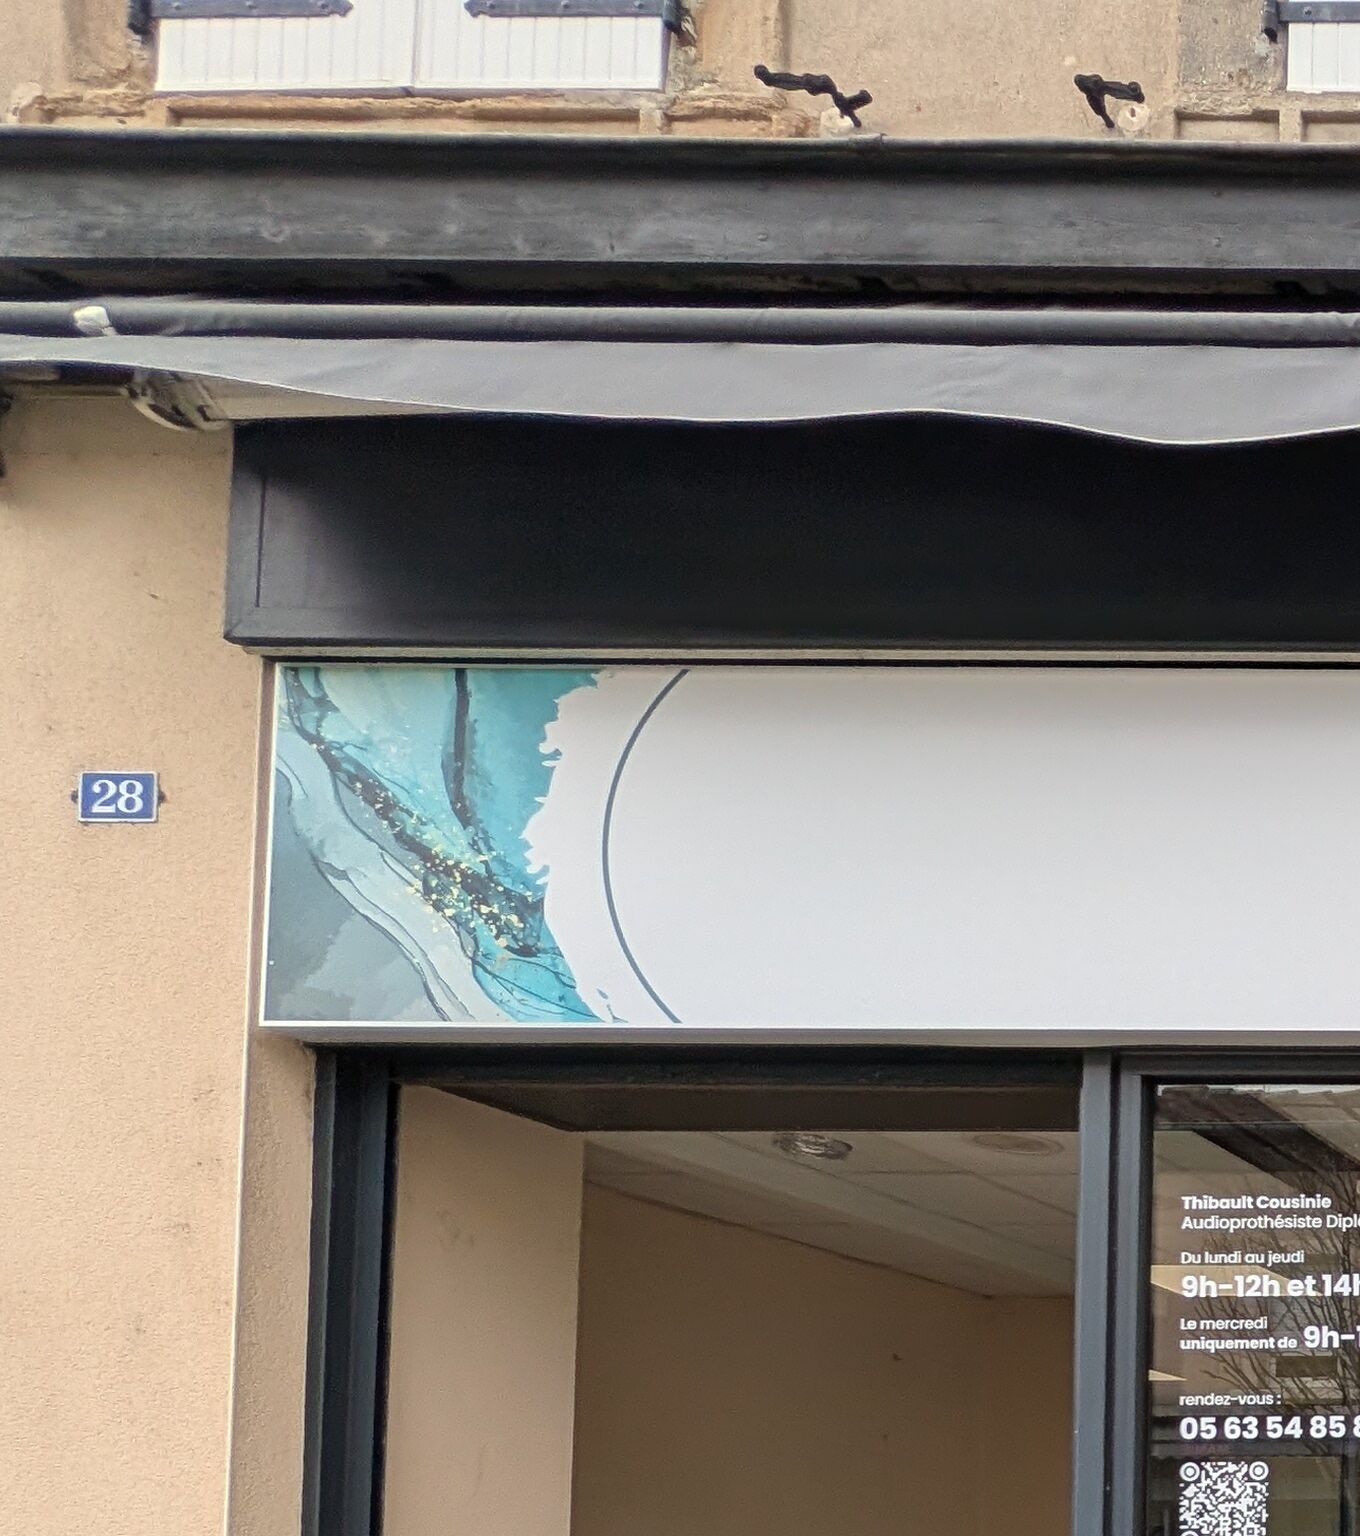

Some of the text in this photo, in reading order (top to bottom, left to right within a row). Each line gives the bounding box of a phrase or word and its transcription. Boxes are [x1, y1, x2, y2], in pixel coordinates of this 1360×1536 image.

[91, 779, 144, 814] 28
[1181, 1194, 1331, 1210] Thibault Cousinie
[1181, 1214, 1322, 1233] Audioprothésiste
[1180, 1250, 1305, 1266] Du lundi au jeudi
[1181, 1274, 1280, 1298] 9h-12h
[1287, 1275, 1317, 1297] et
[1180, 1317, 1268, 1331] Le mercredi
[1180, 1336, 1298, 1353] uniquement de
[1179, 1417, 1217, 1439] 05
[1223, 1416, 1259, 1439] 63
[1266, 1416, 1303, 1438] 54
[1309, 1415, 1347, 1438] 85
